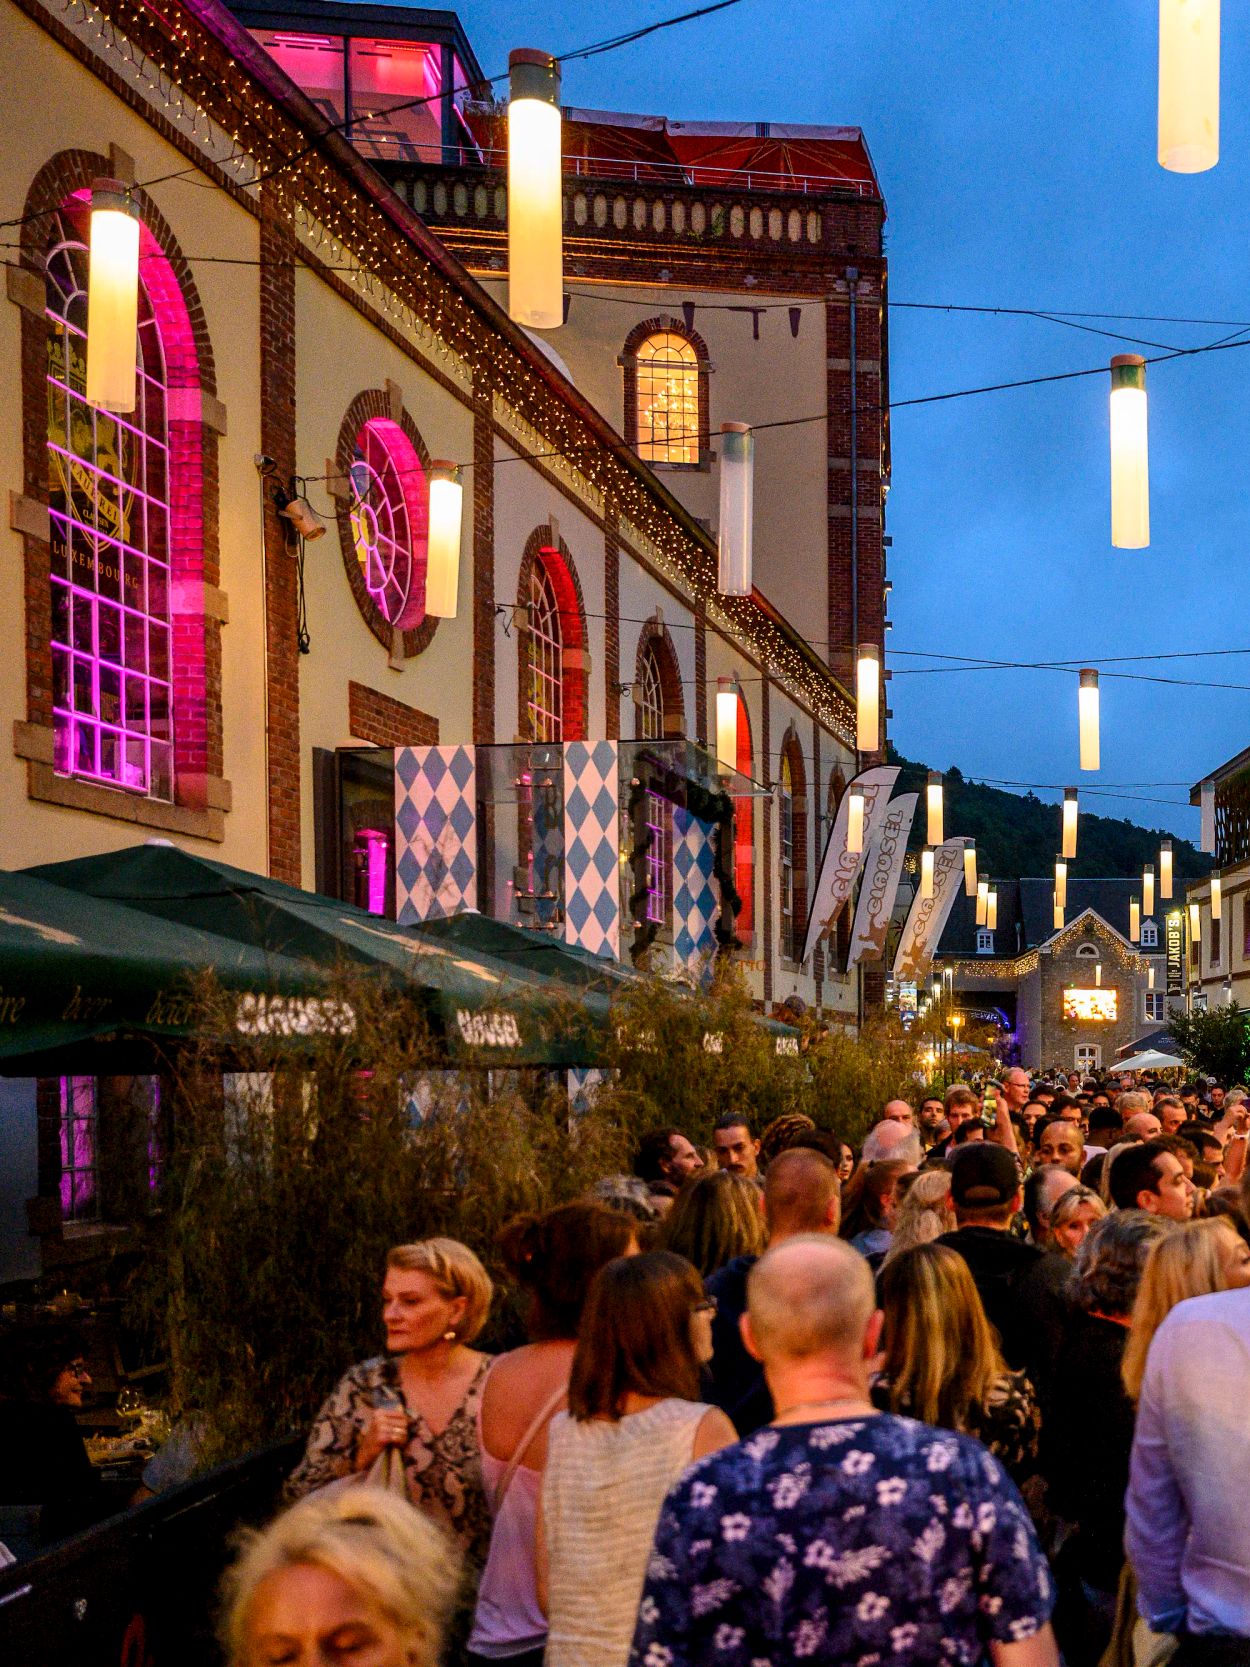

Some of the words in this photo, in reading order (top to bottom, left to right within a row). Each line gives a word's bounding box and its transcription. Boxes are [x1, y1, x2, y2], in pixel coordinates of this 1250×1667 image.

[53, 541, 139, 588] LUXEMBOURG
[831, 784, 880, 899] CLAEL
[1168, 919, 1181, 968] JAKOB'S
